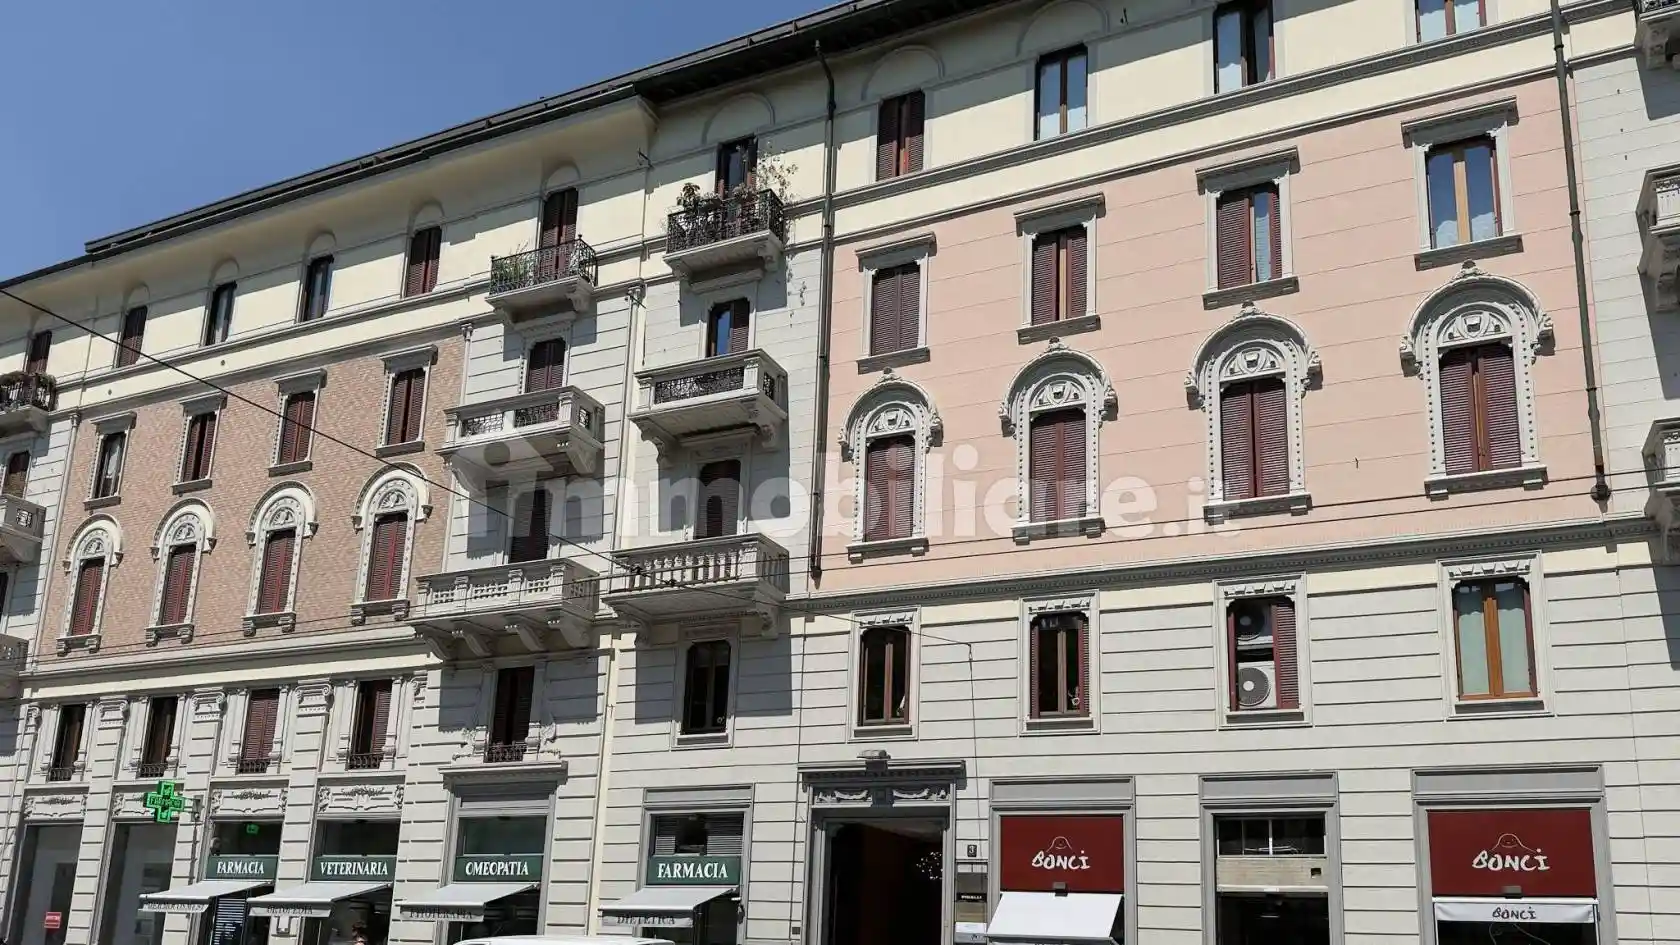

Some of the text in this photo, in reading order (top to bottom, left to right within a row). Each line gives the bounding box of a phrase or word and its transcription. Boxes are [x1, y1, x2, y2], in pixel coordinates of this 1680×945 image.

[1031, 850, 1091, 870] BONCI
[1472, 848, 1551, 871] BONCI
[216, 860, 265, 874] FARMACIA
[320, 861, 389, 875] VETERINARIA
[465, 861, 529, 876] OMEOPATIA
[657, 862, 729, 878] FARMACIA
[616, 914, 675, 925] DIETETICA
[1492, 906, 1536, 920] BONCI
